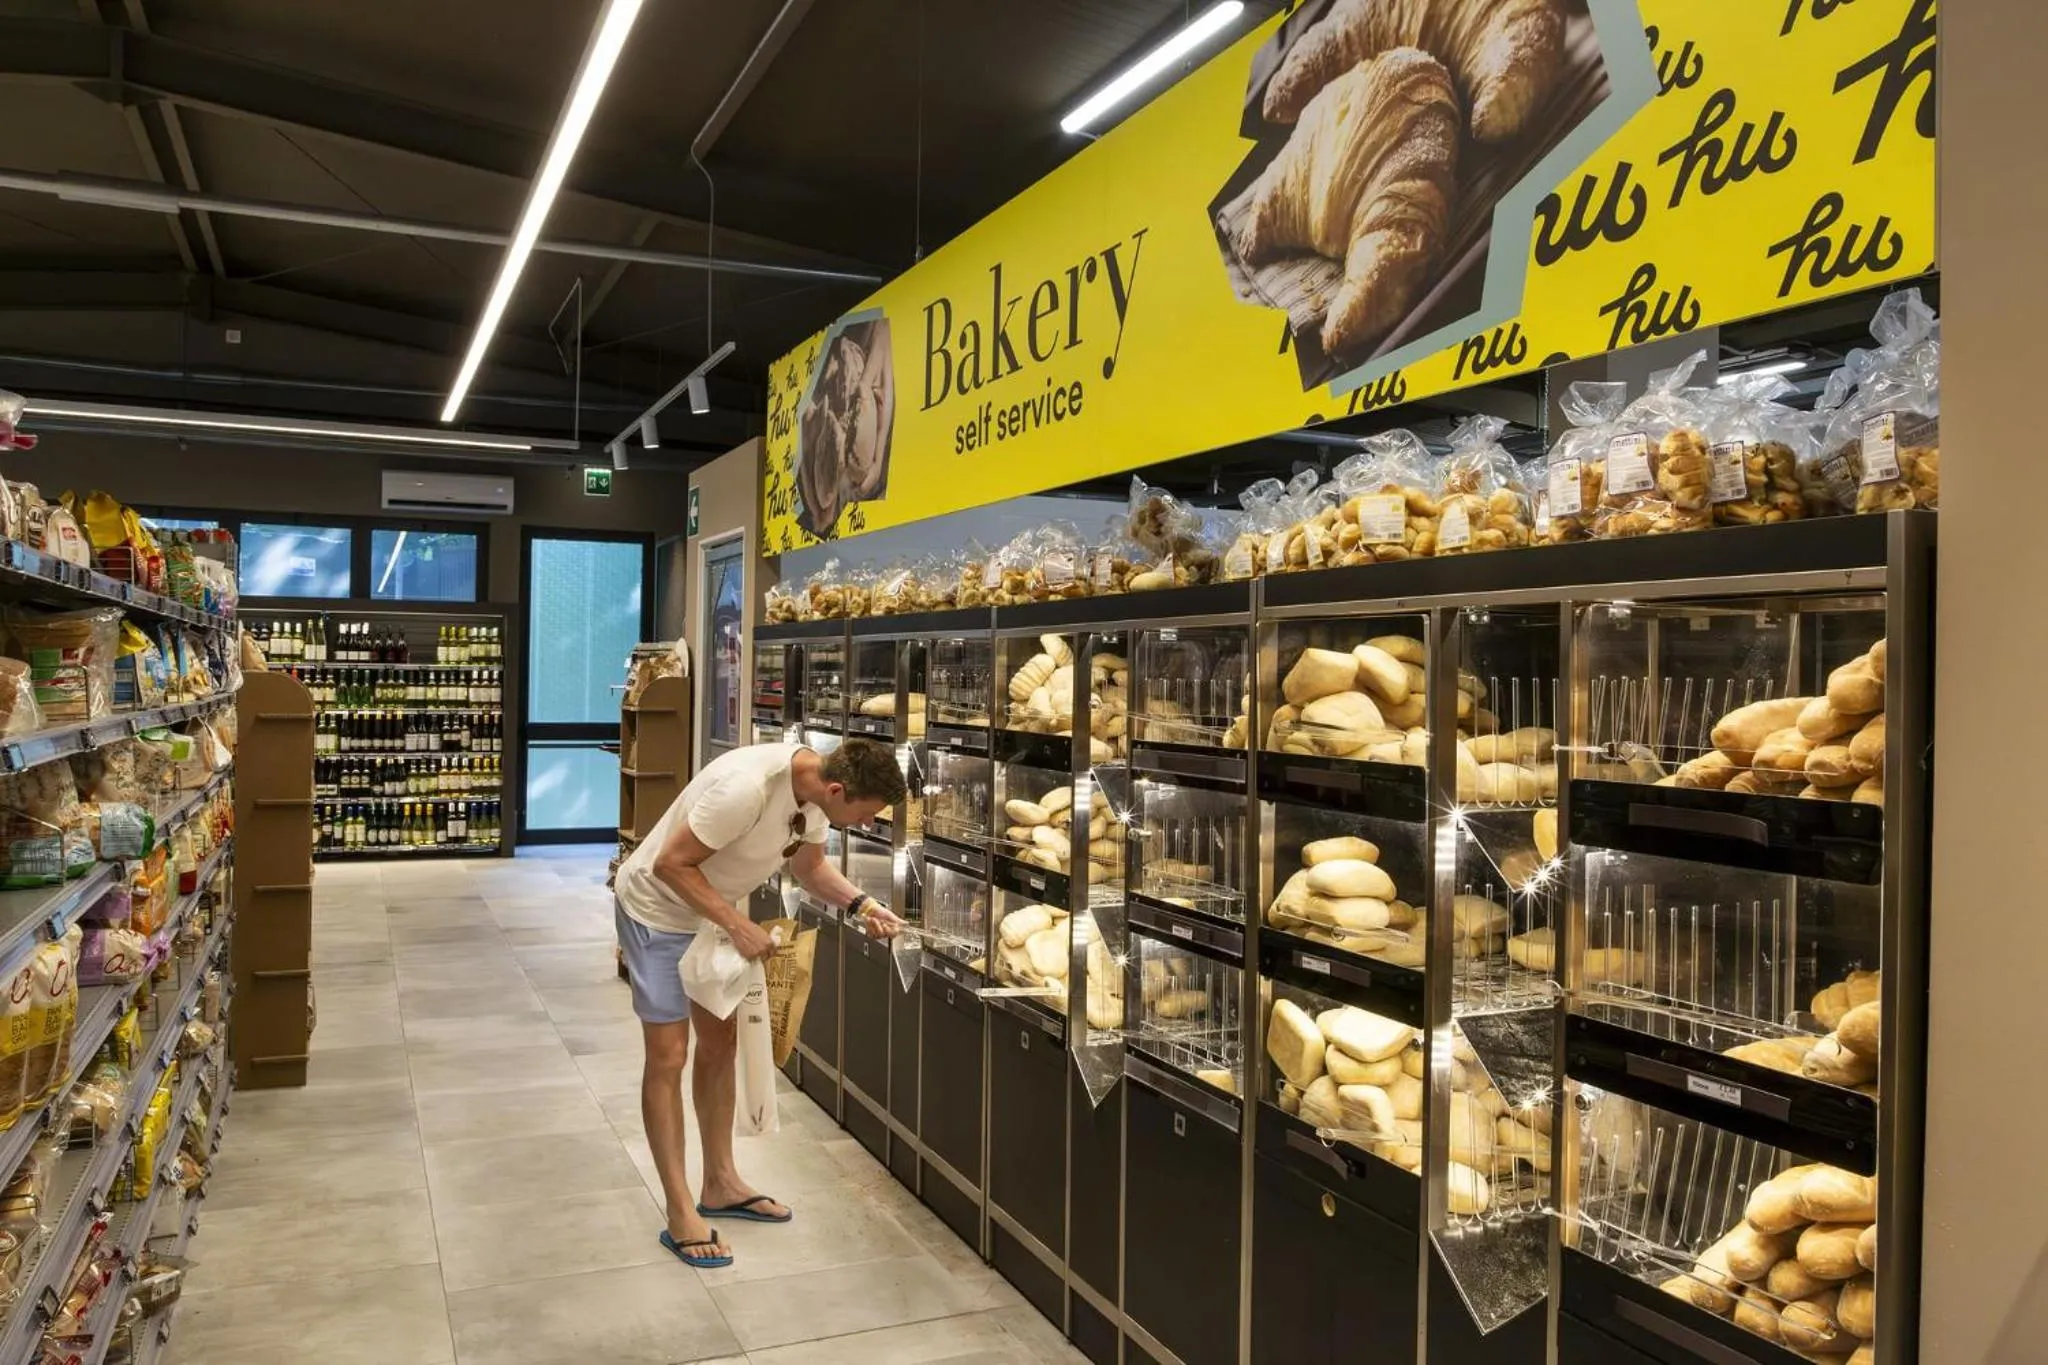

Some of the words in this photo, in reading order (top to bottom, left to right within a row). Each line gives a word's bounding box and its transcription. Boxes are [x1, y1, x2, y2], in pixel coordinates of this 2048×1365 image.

[1657, 88, 1798, 210] hu
[1766, 191, 1904, 299] hu
[920, 228, 1148, 412] Bakery
[1599, 263, 1701, 351] hu
[769, 392, 791, 444] hu
[955, 401, 994, 456] self
[996, 378, 1084, 442] service
[766, 471, 789, 521] hu
